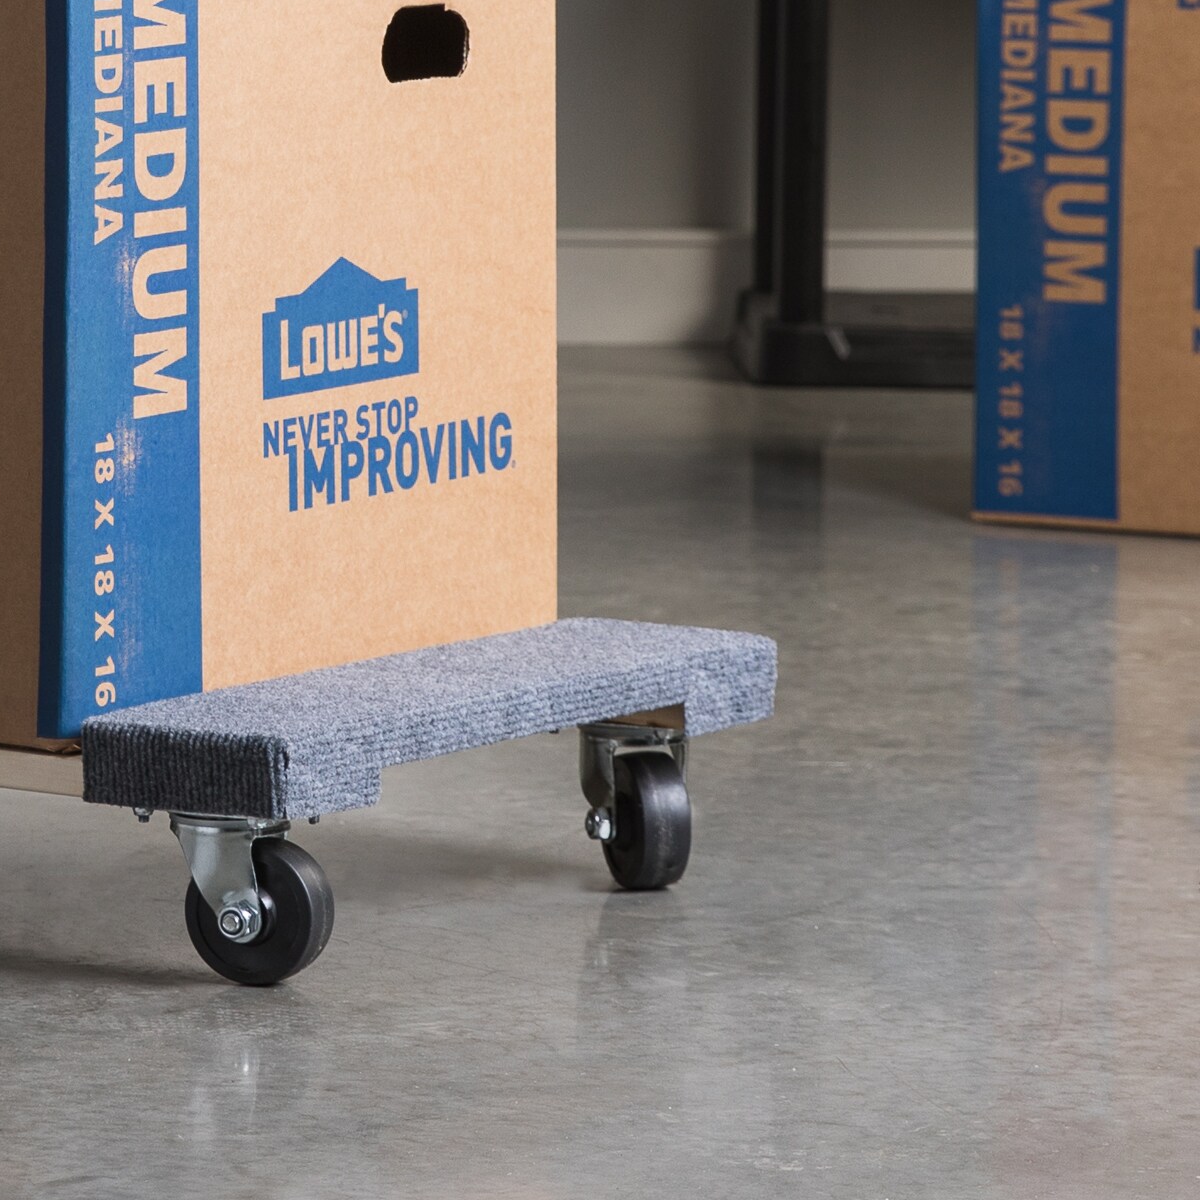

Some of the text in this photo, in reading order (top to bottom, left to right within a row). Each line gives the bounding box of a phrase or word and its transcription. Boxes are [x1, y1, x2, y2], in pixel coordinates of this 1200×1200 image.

[280, 302, 405, 381] LOWE'S
[263, 396, 419, 459] NEVER STOP
[288, 412, 514, 512] IMPROVING
[93, 432, 117, 708] 18 X 18 X 16
